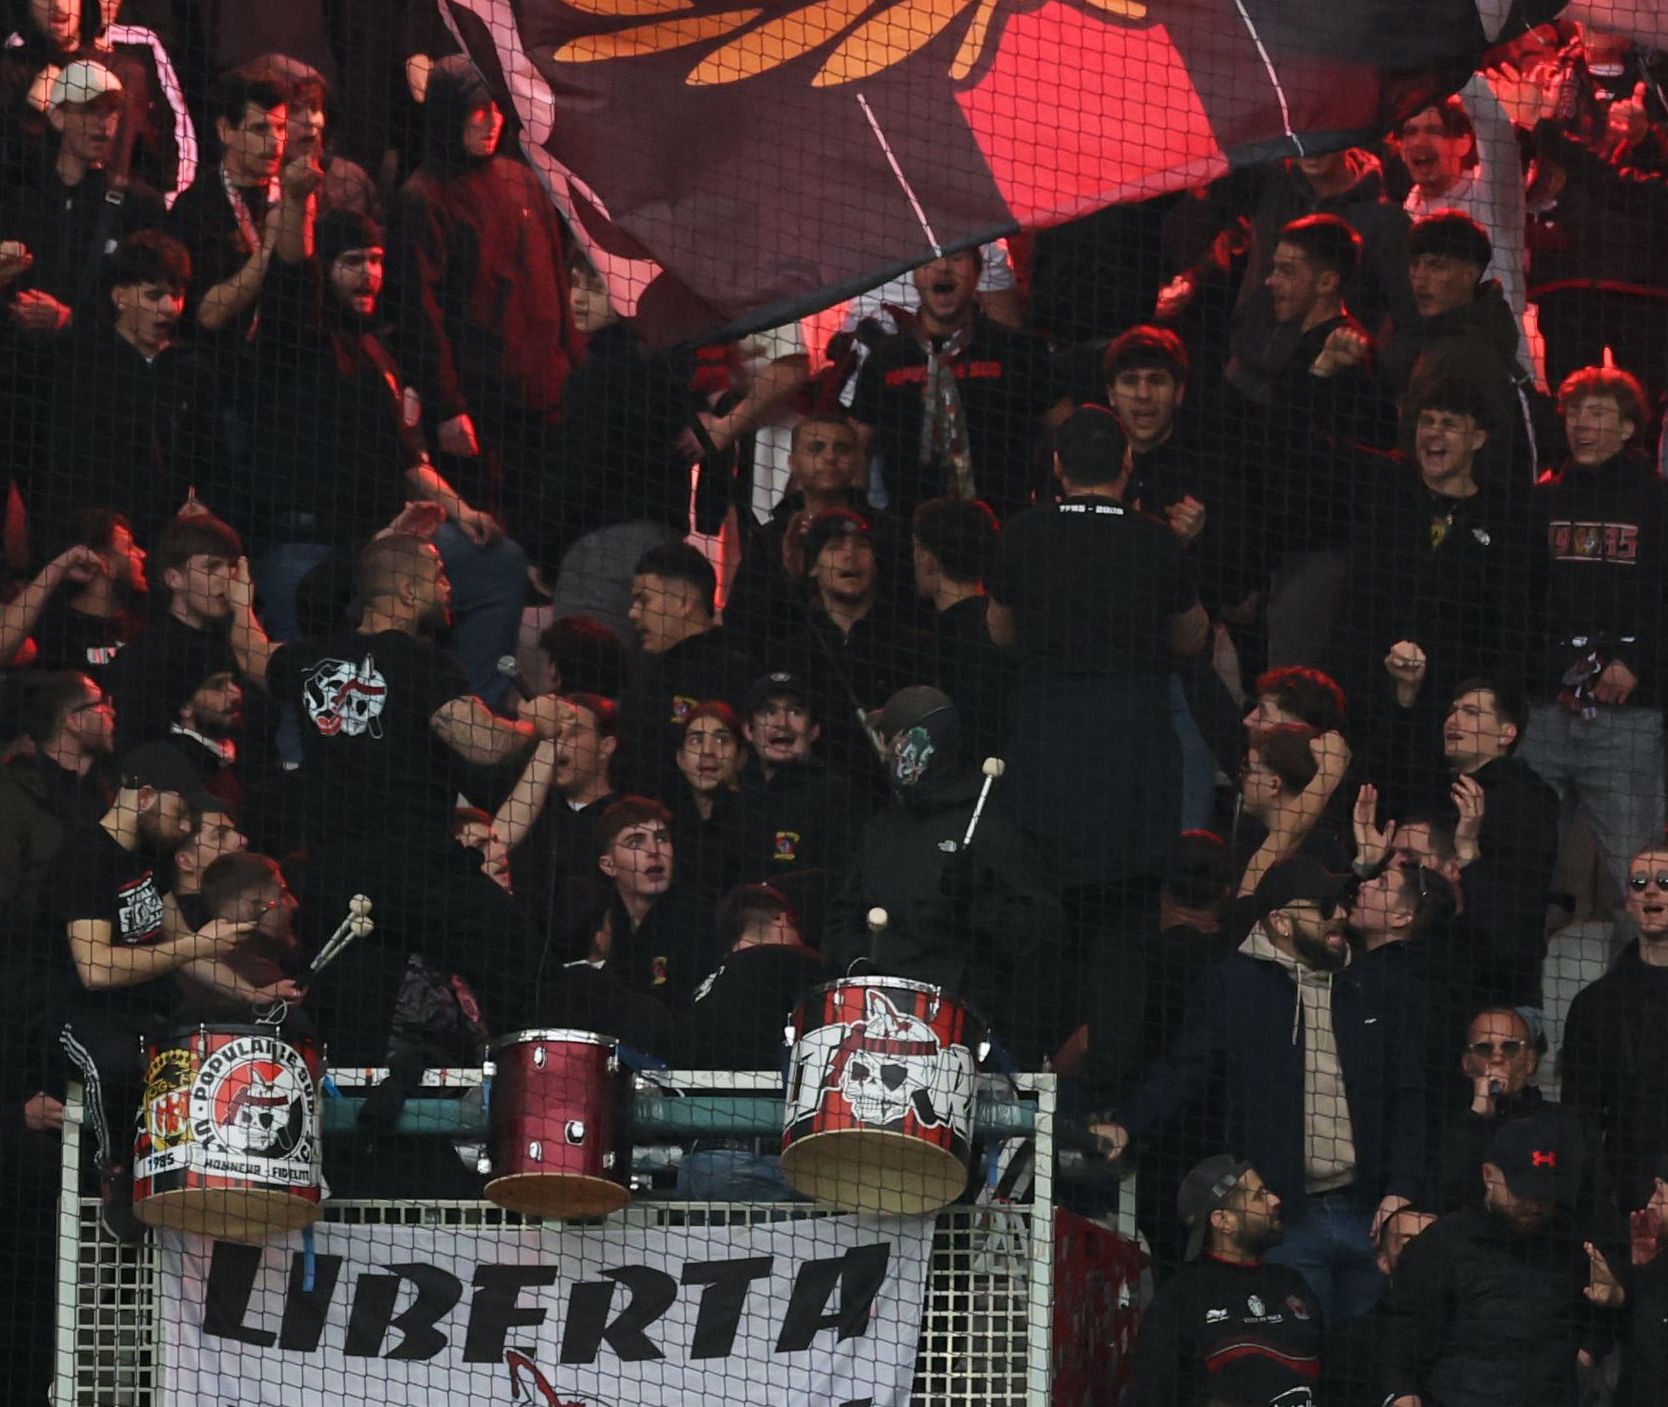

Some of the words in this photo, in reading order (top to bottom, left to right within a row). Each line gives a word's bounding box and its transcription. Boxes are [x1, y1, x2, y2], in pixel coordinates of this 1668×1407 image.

[194, 1038, 299, 1101] POPULAIRE
[148, 1152, 175, 1172] 1985
[202, 1240, 891, 1365] LIBERTA
